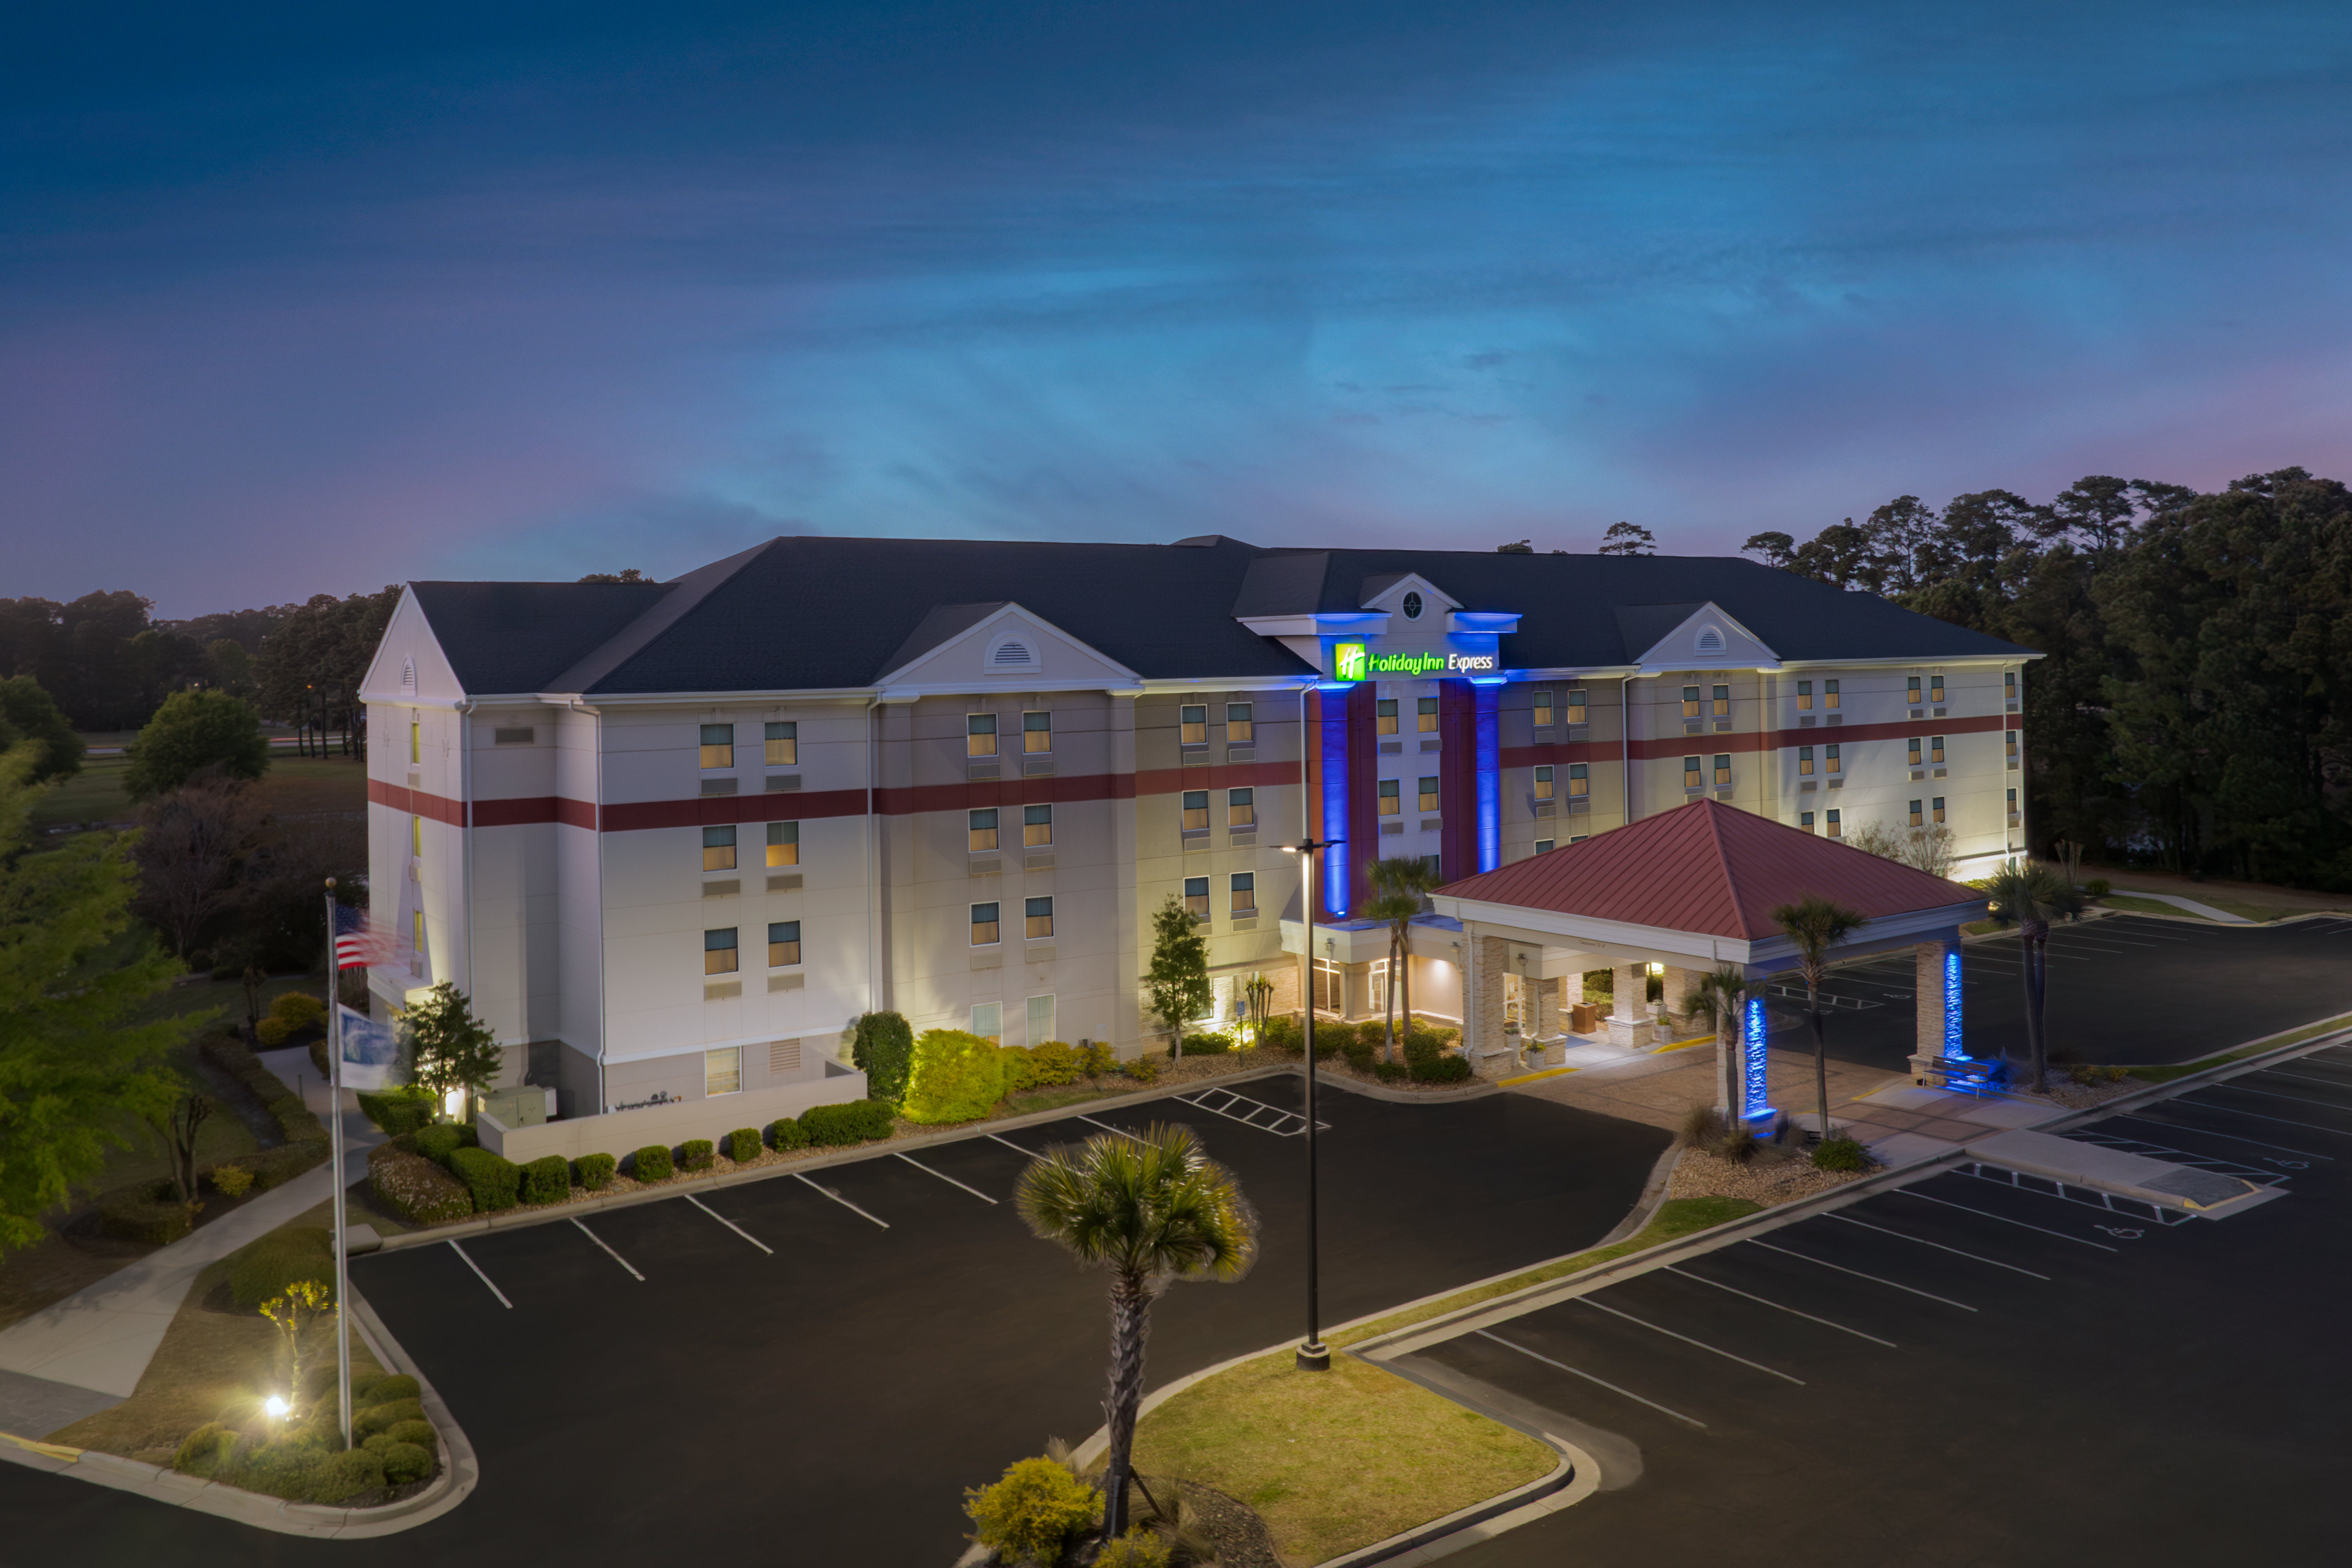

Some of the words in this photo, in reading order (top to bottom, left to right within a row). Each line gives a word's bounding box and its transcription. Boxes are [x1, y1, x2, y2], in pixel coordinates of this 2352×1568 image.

[1368, 653, 1422, 675] Holiday
[1424, 652, 1444, 670] Inn
[1448, 654, 1493, 673] Express
